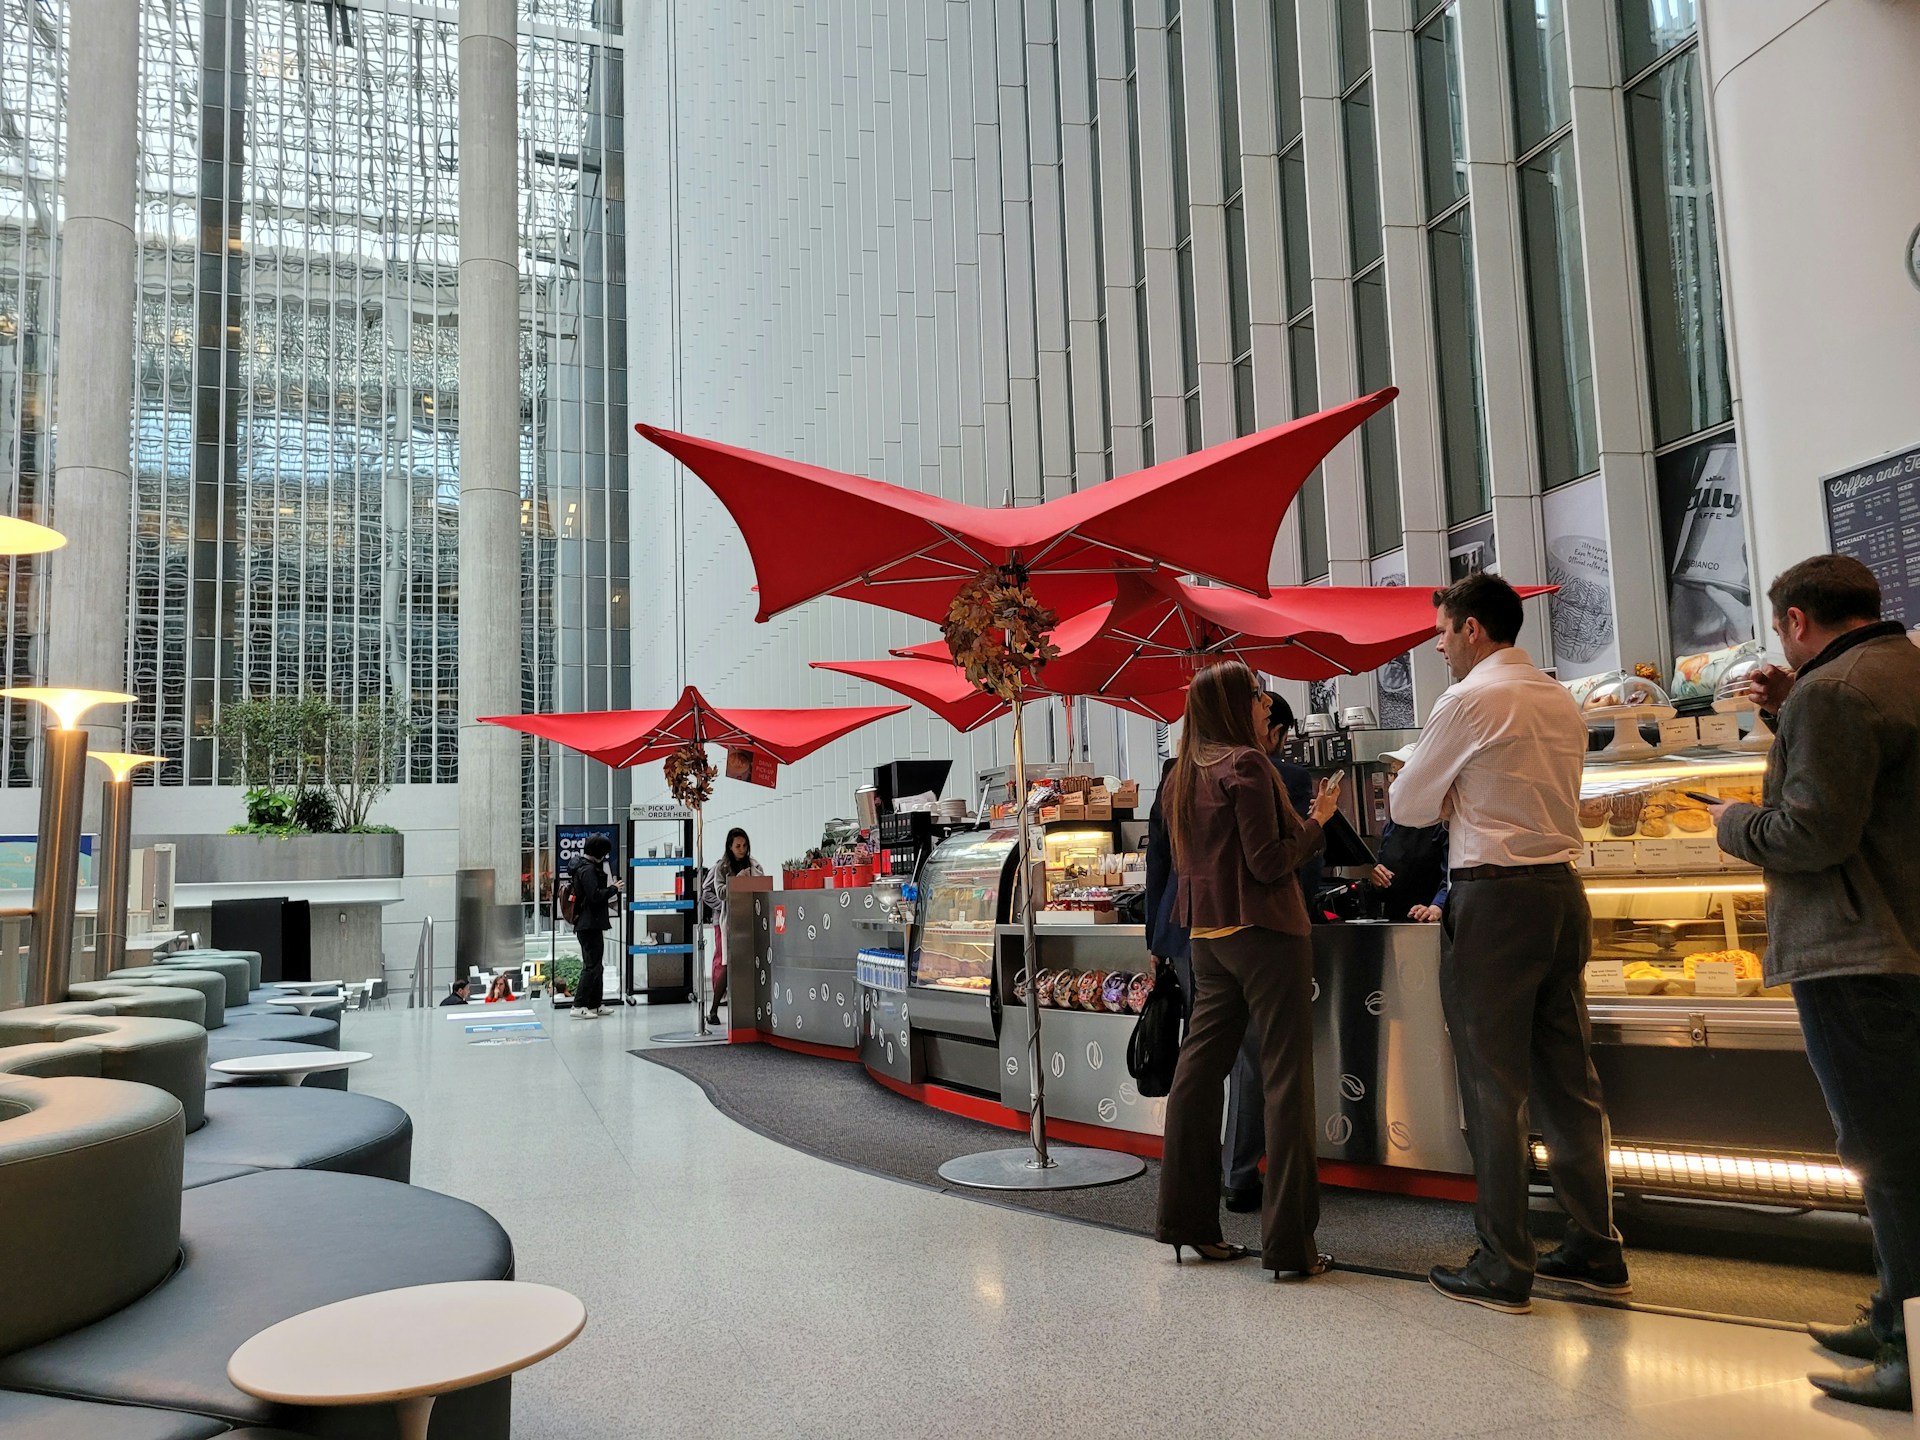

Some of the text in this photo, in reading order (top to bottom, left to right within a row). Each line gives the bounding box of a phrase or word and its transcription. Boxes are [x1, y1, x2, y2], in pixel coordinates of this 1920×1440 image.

[1830, 474, 1874, 498] Coffee
[1876, 461, 1903, 482] and
[1833, 502, 1855, 513] COFFEE
[1902, 527, 1915, 536] TEA
[1836, 534, 1867, 547] SPECIALTY
[1690, 560, 1720, 571] BIANCO
[560, 838, 586, 849] Ord
